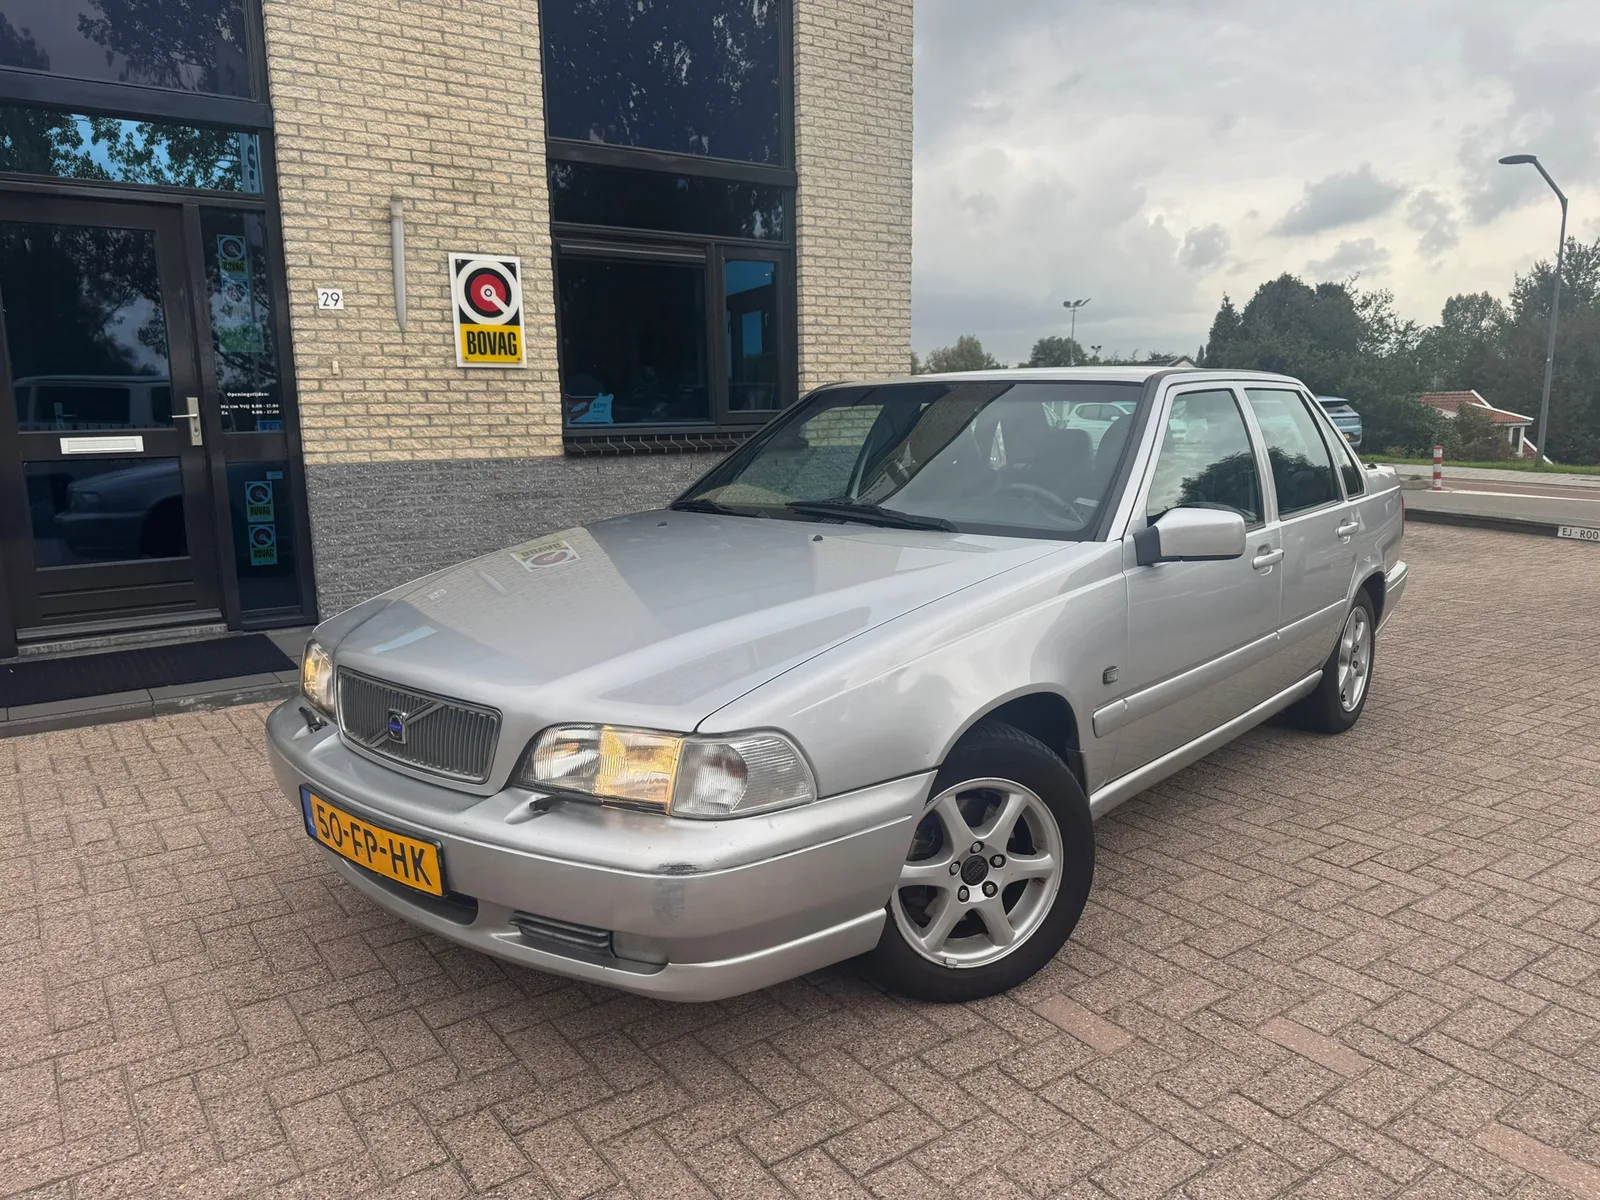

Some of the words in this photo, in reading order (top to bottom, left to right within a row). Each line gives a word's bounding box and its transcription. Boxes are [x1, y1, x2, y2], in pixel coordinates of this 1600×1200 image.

[223, 261, 245, 272] BOVAG
[321, 291, 340, 307] 29
[466, 330, 518, 356] BOVAG
[250, 505, 271, 516] BOVAG
[254, 548, 274, 560] BOVAG
[316, 803, 433, 887] 50-FP-HK
